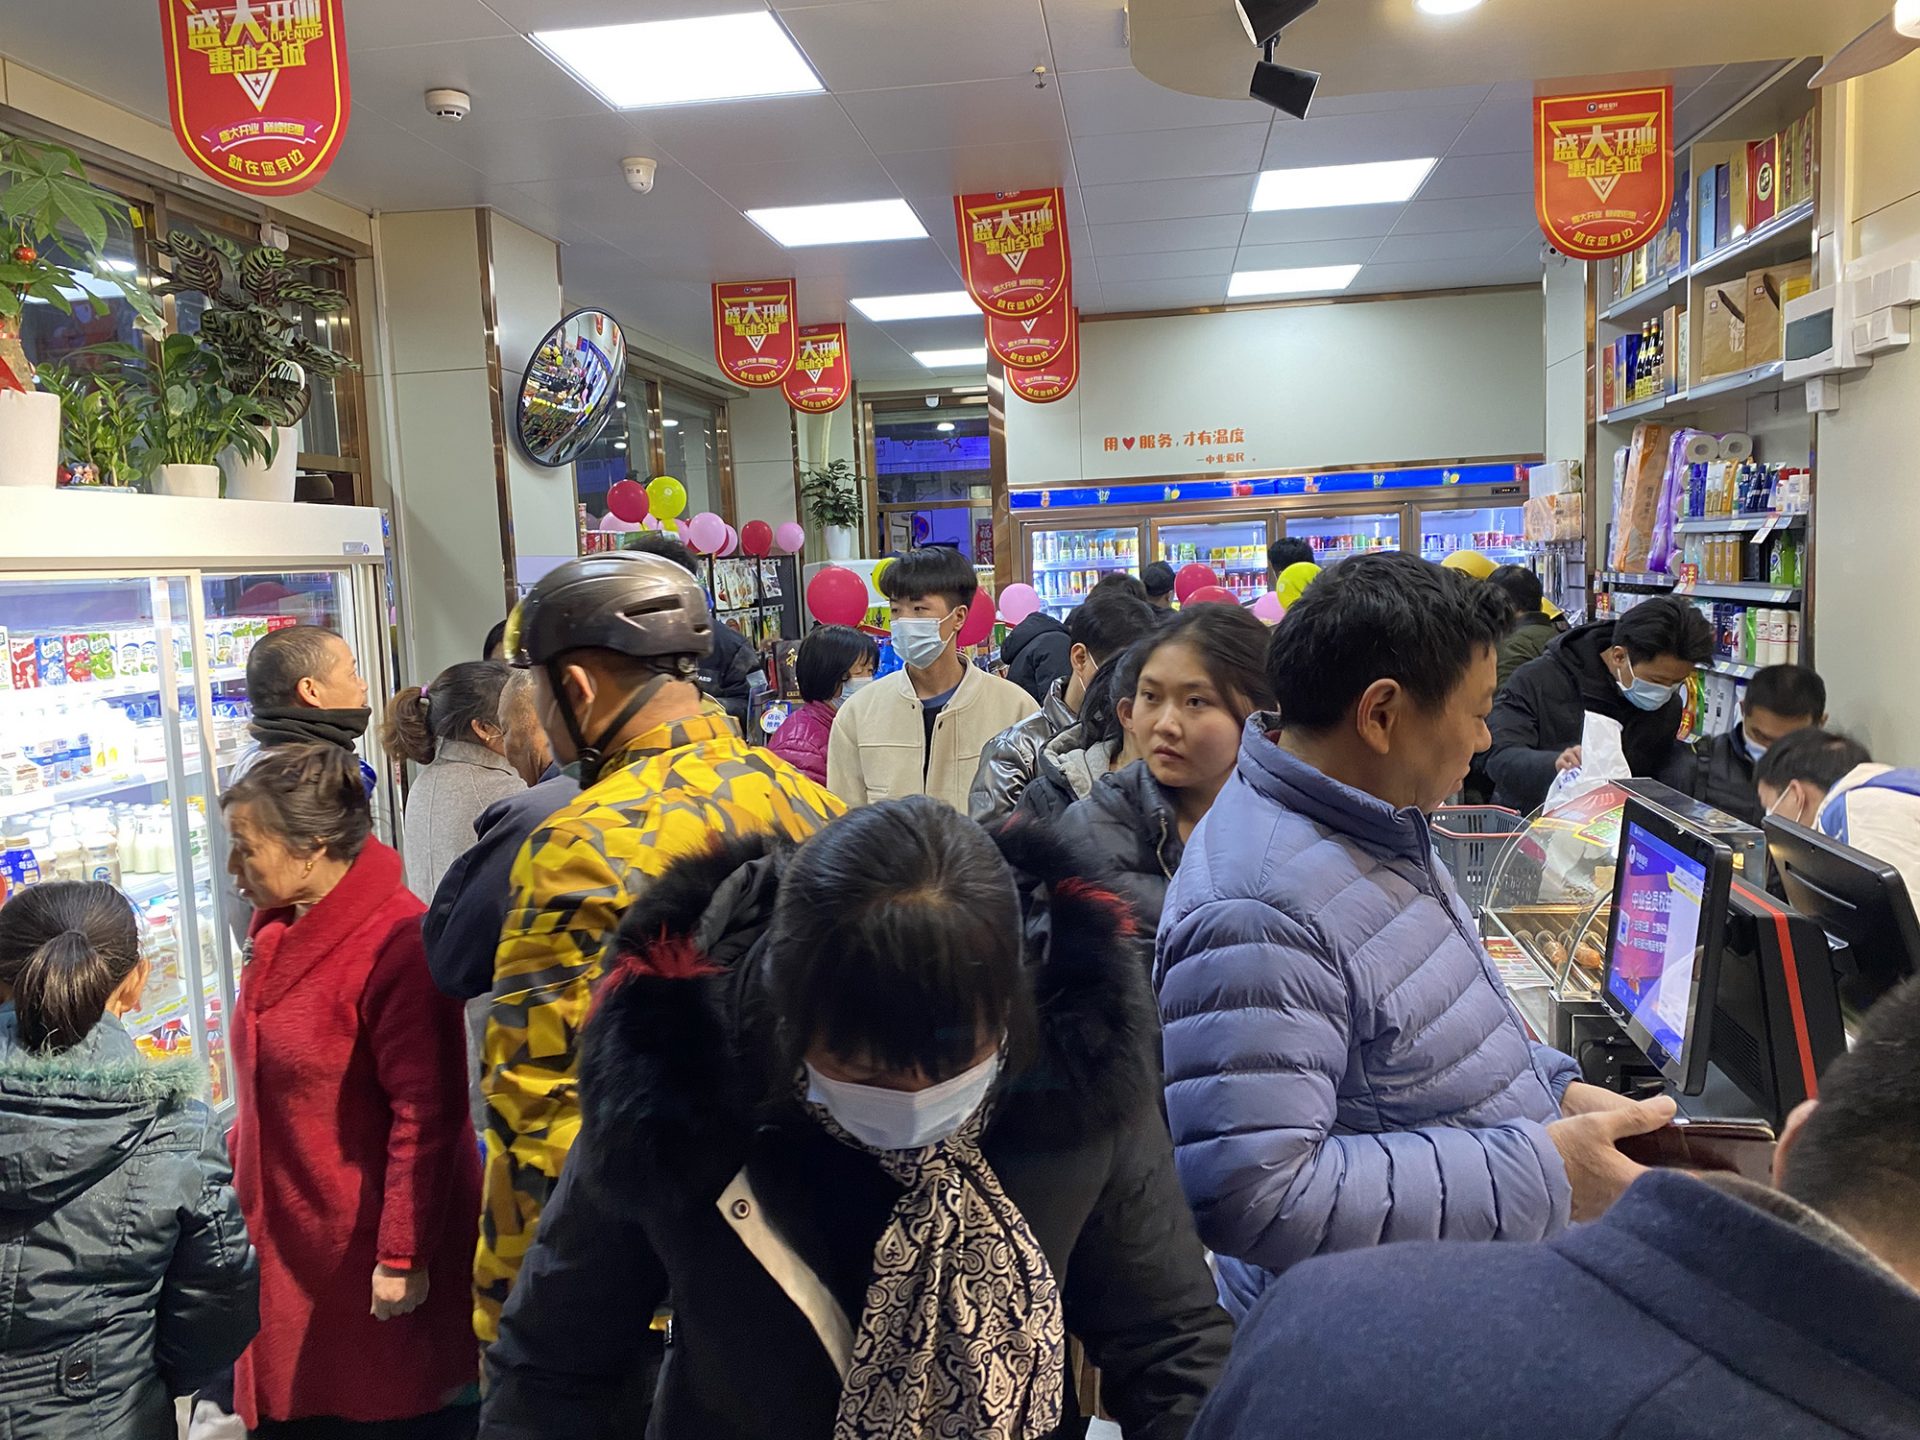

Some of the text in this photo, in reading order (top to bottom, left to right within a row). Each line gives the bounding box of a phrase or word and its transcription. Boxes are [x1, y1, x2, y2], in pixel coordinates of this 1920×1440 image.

[187, 0, 322, 48] 盛大开业
[271, 27, 324, 42] OPENING
[1553, 124, 1657, 162] 盛大开业
[228, 149, 306, 177] 就在您身边
[972, 209, 1054, 243] 盛大开业
[725, 301, 788, 326] 盛大开业
[799, 340, 841, 359] 大开业
[1103, 437, 1119, 452] 用
